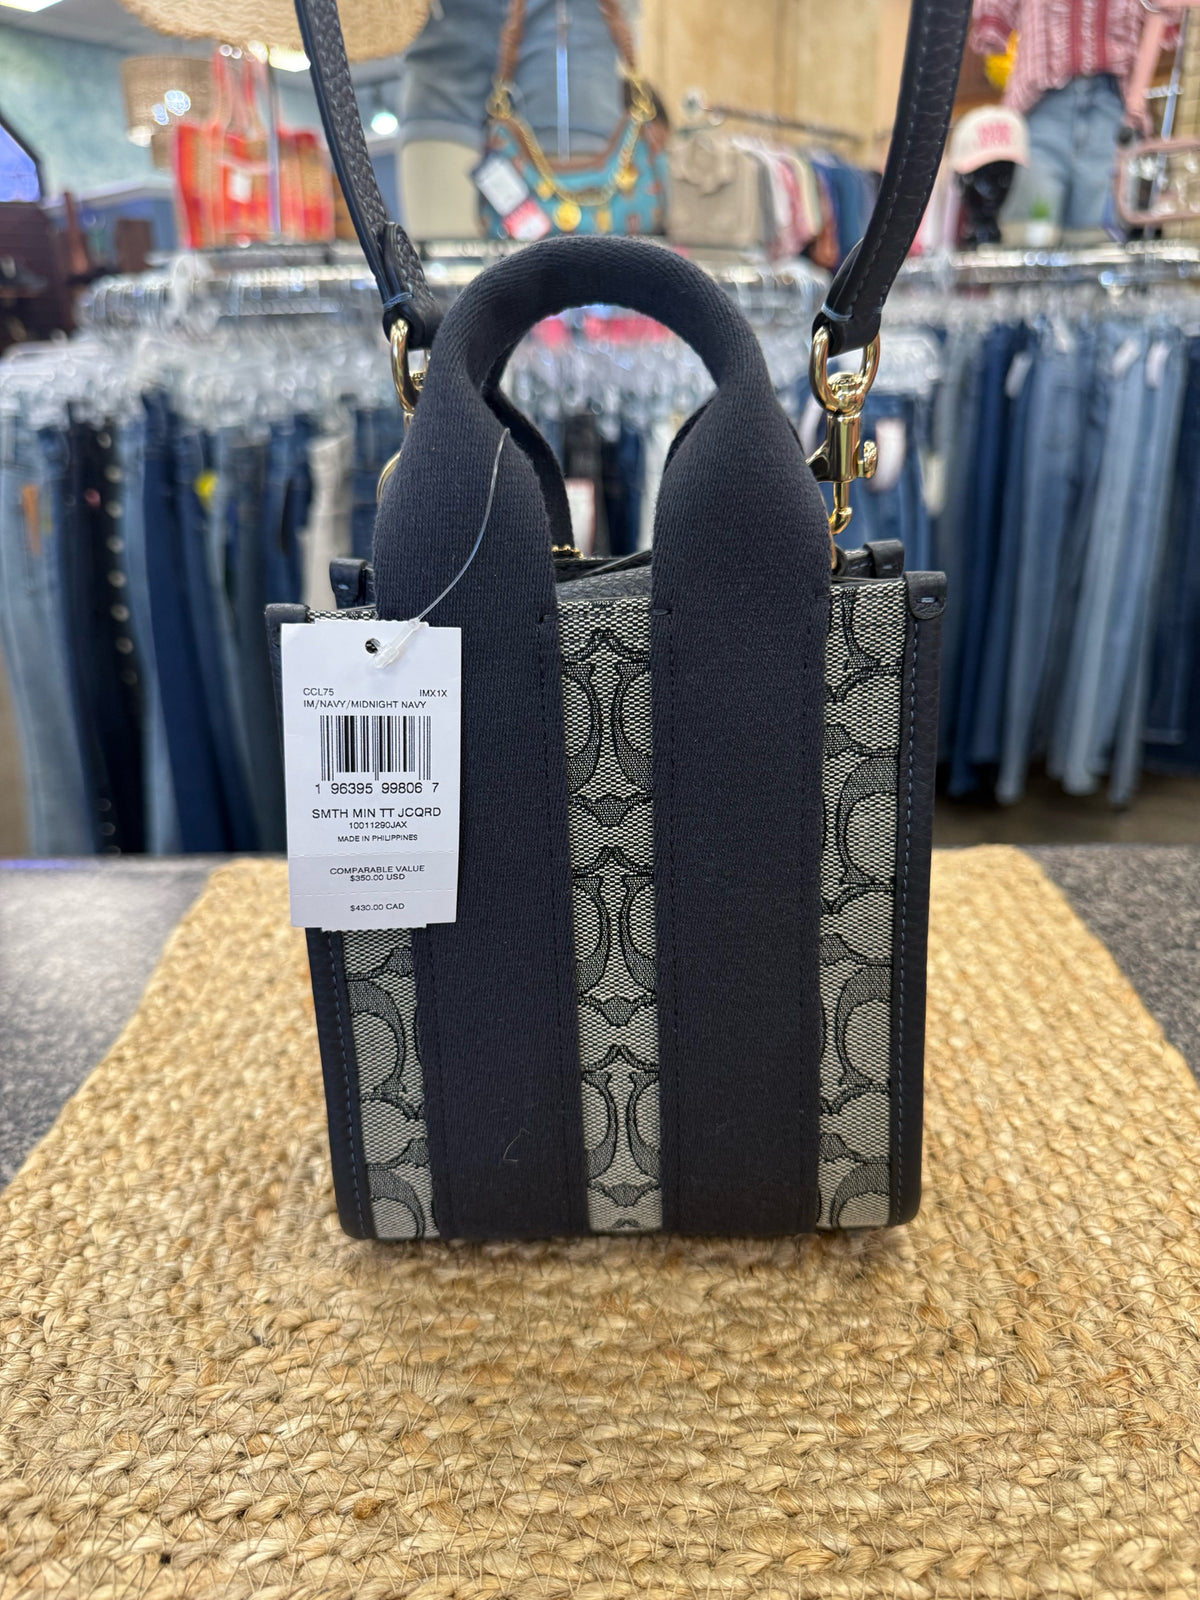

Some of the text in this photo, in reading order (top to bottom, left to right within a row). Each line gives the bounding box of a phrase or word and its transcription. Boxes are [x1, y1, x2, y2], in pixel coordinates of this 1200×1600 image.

[303, 687, 335, 697] CCL75
[303, 699, 427, 710] IM/NAVY/MIDNIGHT NAVY
[315, 782, 440, 795] 1 96395 99806 7
[312, 807, 442, 819] SMTH MIN TT JCQRD
[348, 820, 408, 830] 10011290JAX
[337, 835, 360, 843] MADE
[372, 833, 418, 842] PHILIPPINES
[329, 864, 425, 875] COMPARABLE VALUE
[350, 873, 406, 882] $350.00 USD
[350, 902, 405, 912] $430.00 CAD
